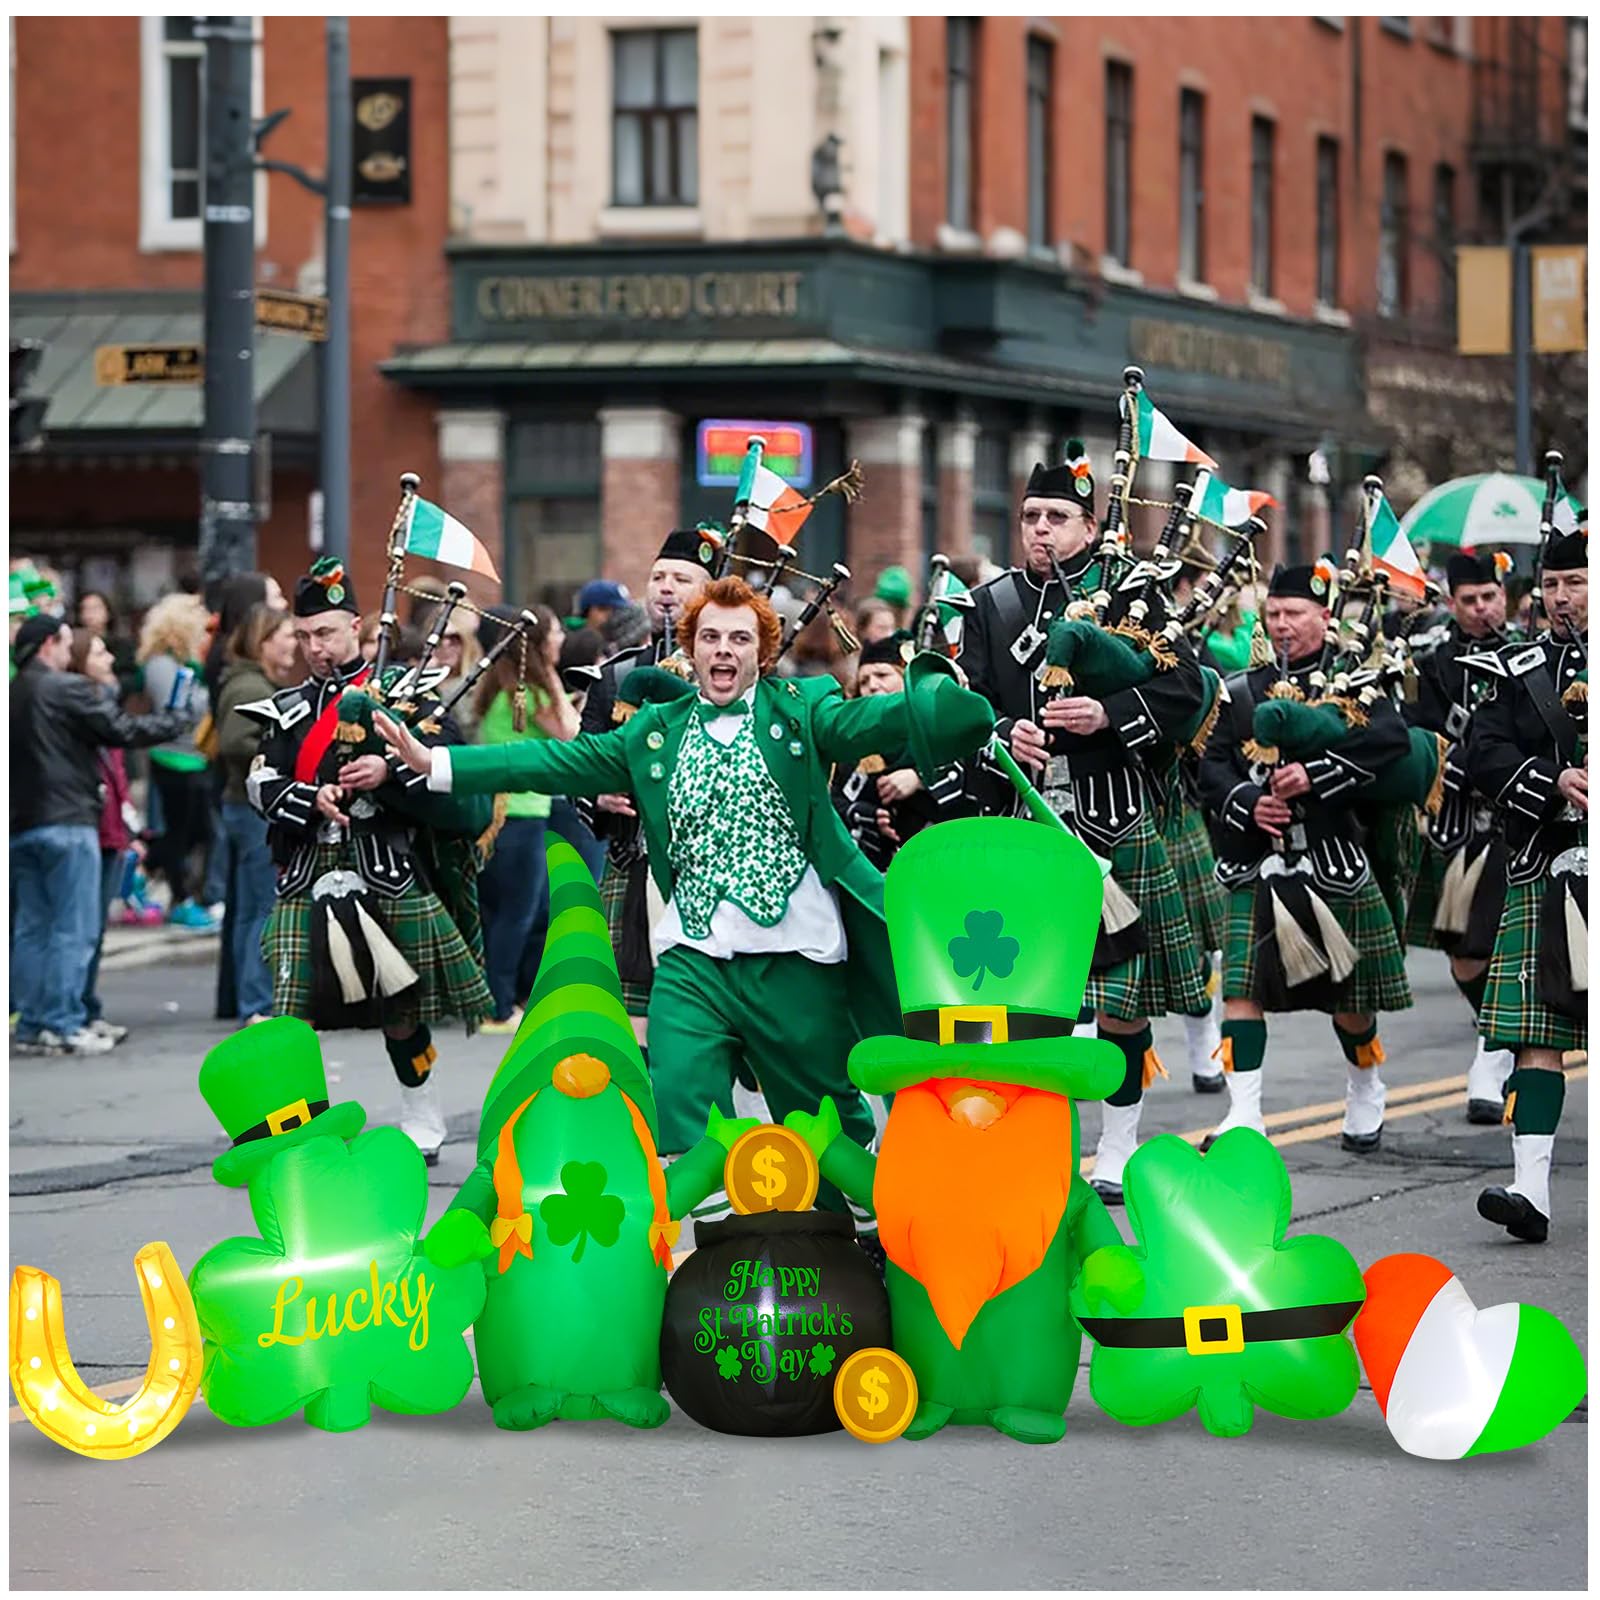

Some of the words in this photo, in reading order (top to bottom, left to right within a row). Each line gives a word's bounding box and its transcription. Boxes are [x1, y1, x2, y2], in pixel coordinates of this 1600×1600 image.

[606, 273, 691, 320] FOOD
[693, 270, 803, 318] COURT
[751, 1144, 788, 1206] $
[257, 1258, 436, 1352] Lucky
[722, 1259, 822, 1302] Happy
[693, 1306, 731, 1354] St.
[727, 1302, 855, 1338] Patrick's
[740, 1338, 811, 1385] Day
[856, 1366, 891, 1420] $
